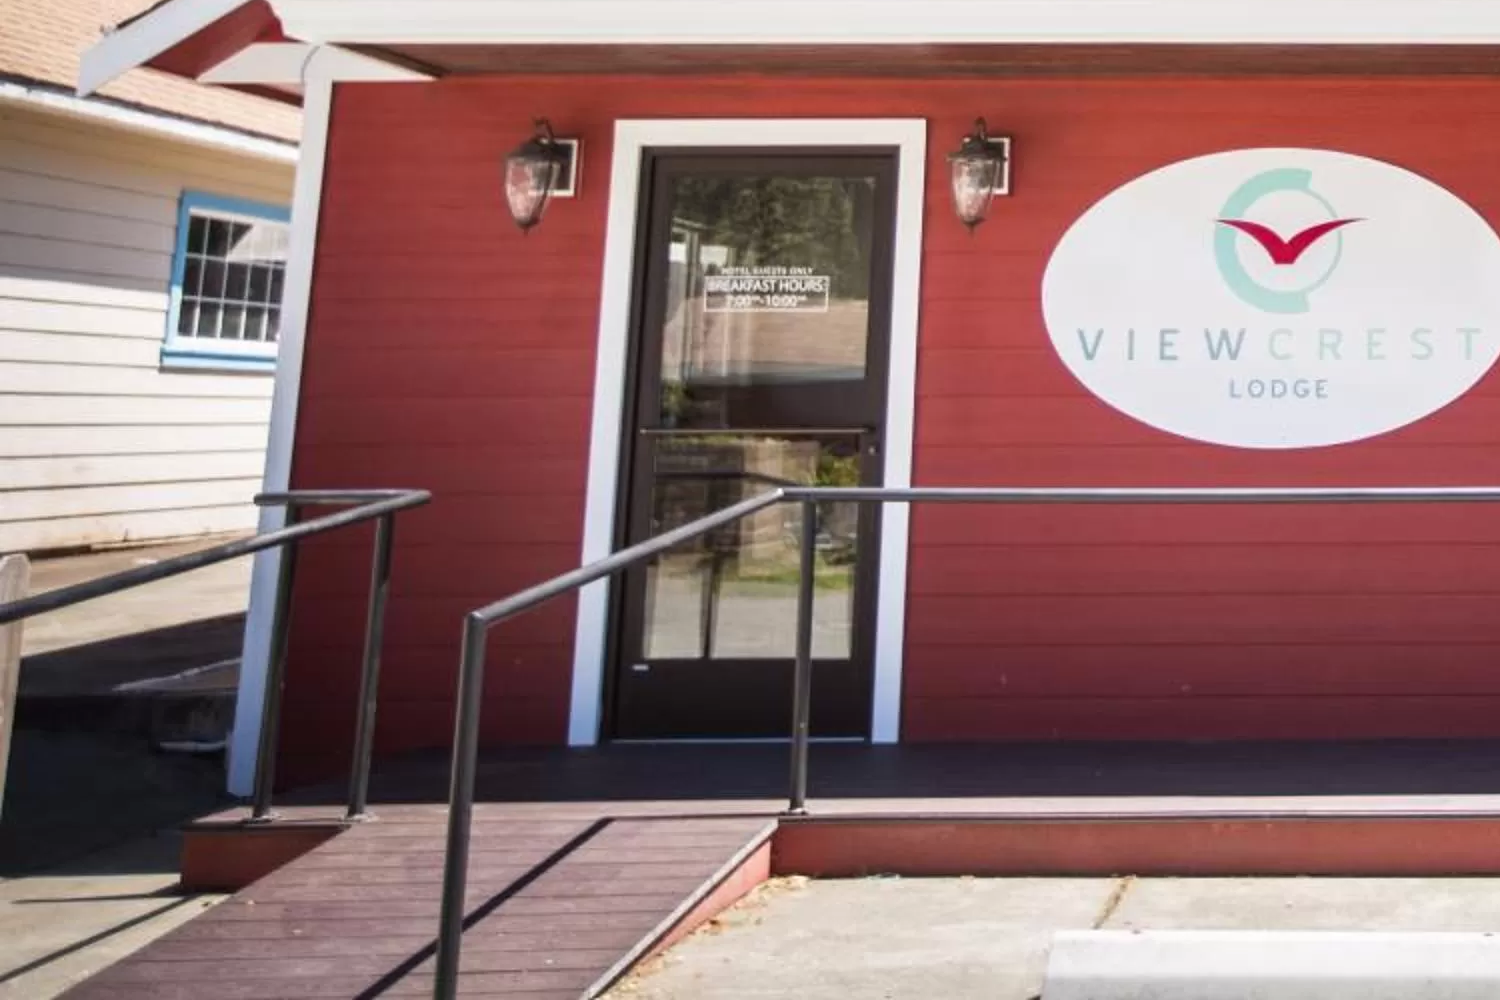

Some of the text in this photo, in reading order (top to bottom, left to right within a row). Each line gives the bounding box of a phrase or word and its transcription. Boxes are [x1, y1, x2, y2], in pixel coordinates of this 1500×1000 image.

[789, 267, 813, 275] ONLY
[707, 279, 775, 292] BREAKFAST
[1229, 379, 1329, 399] LODGE
